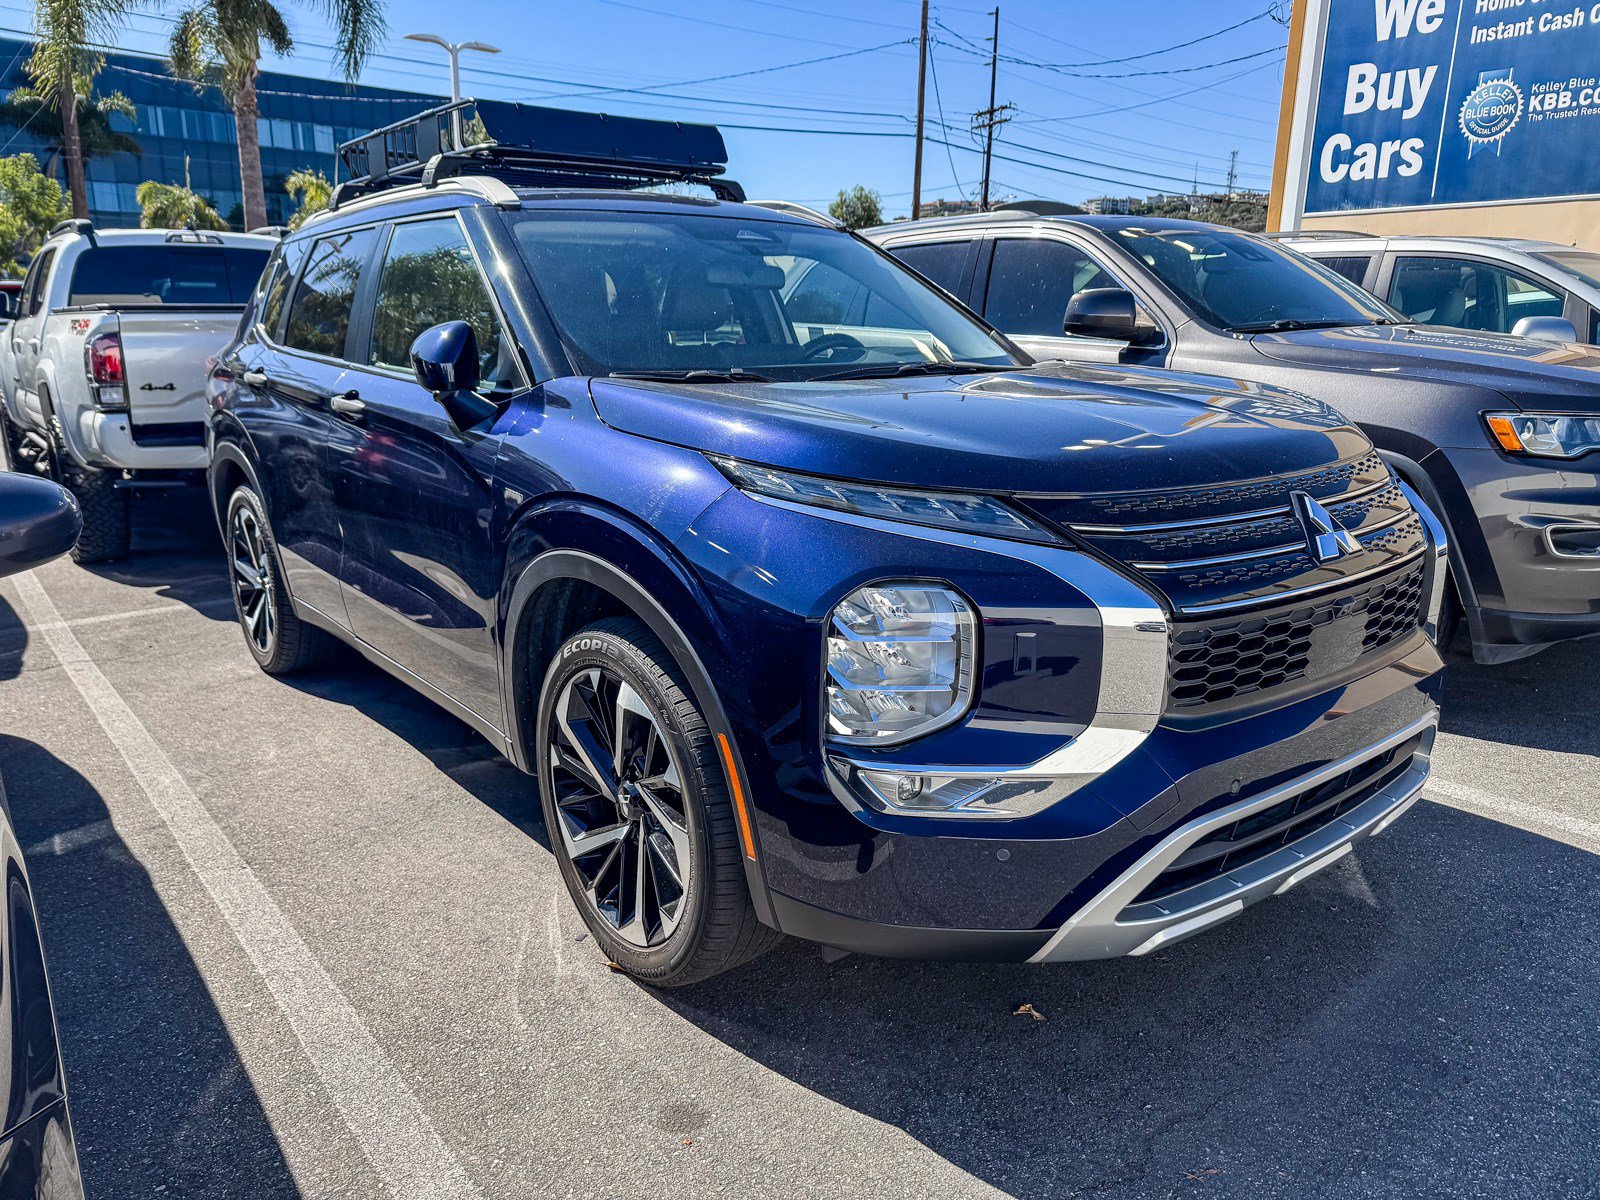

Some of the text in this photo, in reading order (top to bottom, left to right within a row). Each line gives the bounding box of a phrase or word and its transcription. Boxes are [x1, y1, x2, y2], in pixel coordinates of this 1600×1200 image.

[1375, 0, 1446, 42] We
[1470, 16, 1535, 44] Instant
[1538, 7, 1585, 33] Cash
[1343, 62, 1439, 120] Buy
[1531, 77, 1595, 94] Kelley Blue
[1474, 86, 1515, 105] KELLEY
[1466, 103, 1516, 119] BLUE BOOK
[1528, 112, 1543, 122] The
[1546, 108, 1578, 120] Trusted
[1469, 117, 1510, 135] OFFICIAL GUIDE
[1320, 133, 1425, 184] Cars
